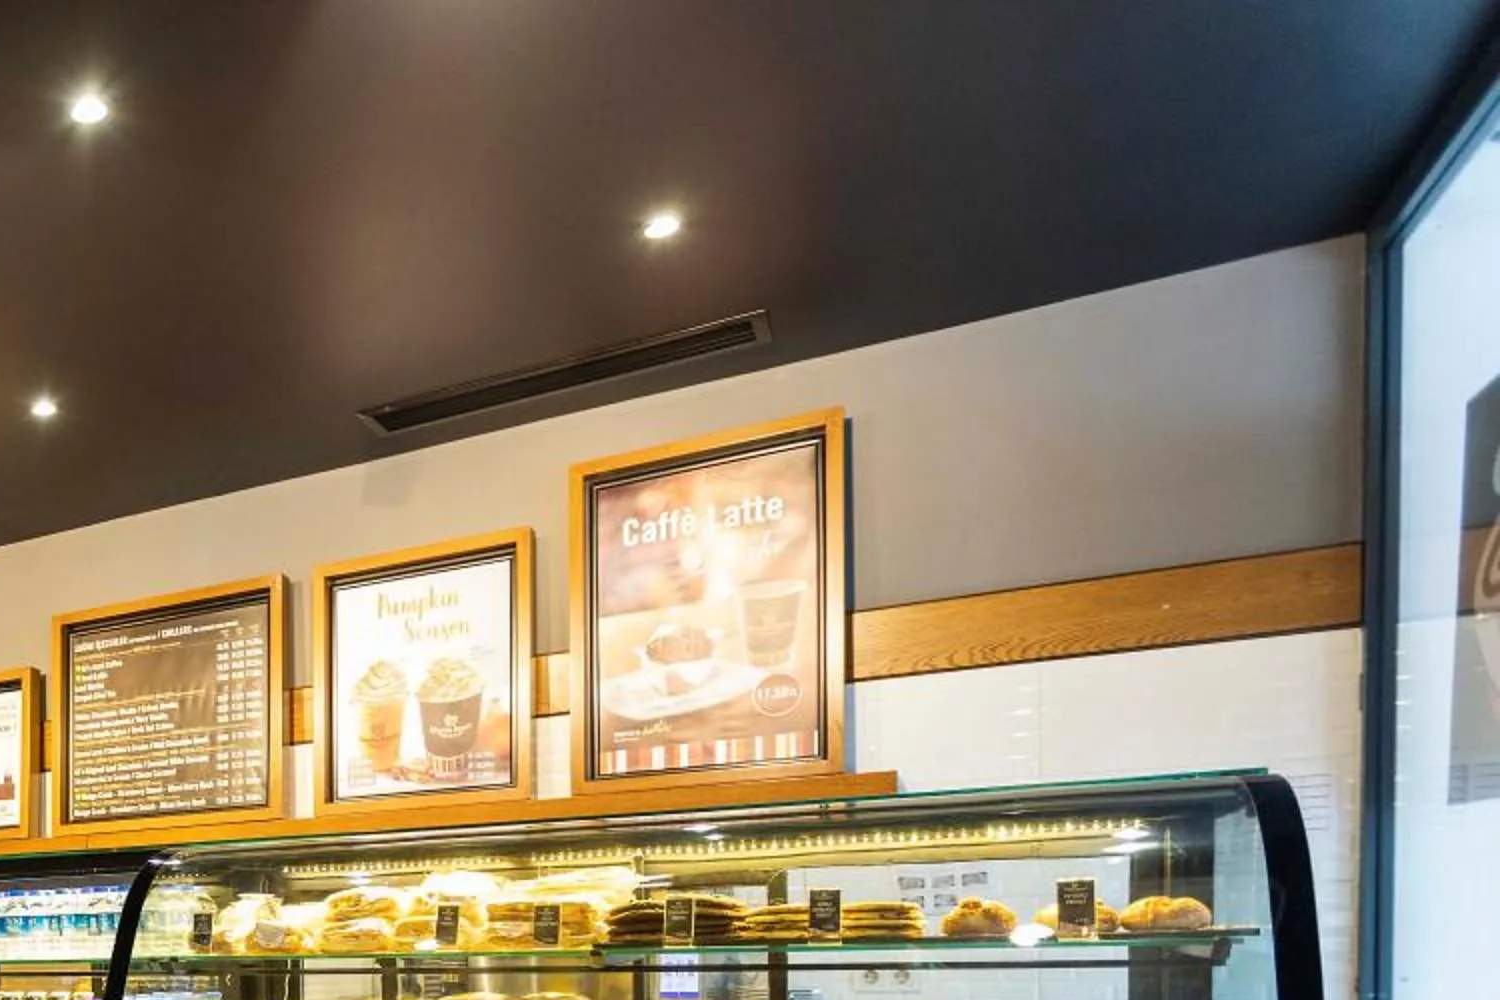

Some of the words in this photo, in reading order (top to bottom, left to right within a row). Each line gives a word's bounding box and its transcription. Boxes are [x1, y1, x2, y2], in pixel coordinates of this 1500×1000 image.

[621, 508, 697, 548] Caffè
[706, 495, 785, 535] Latte
[377, 584, 459, 621] Pumpkin
[404, 618, 470, 641] Season
